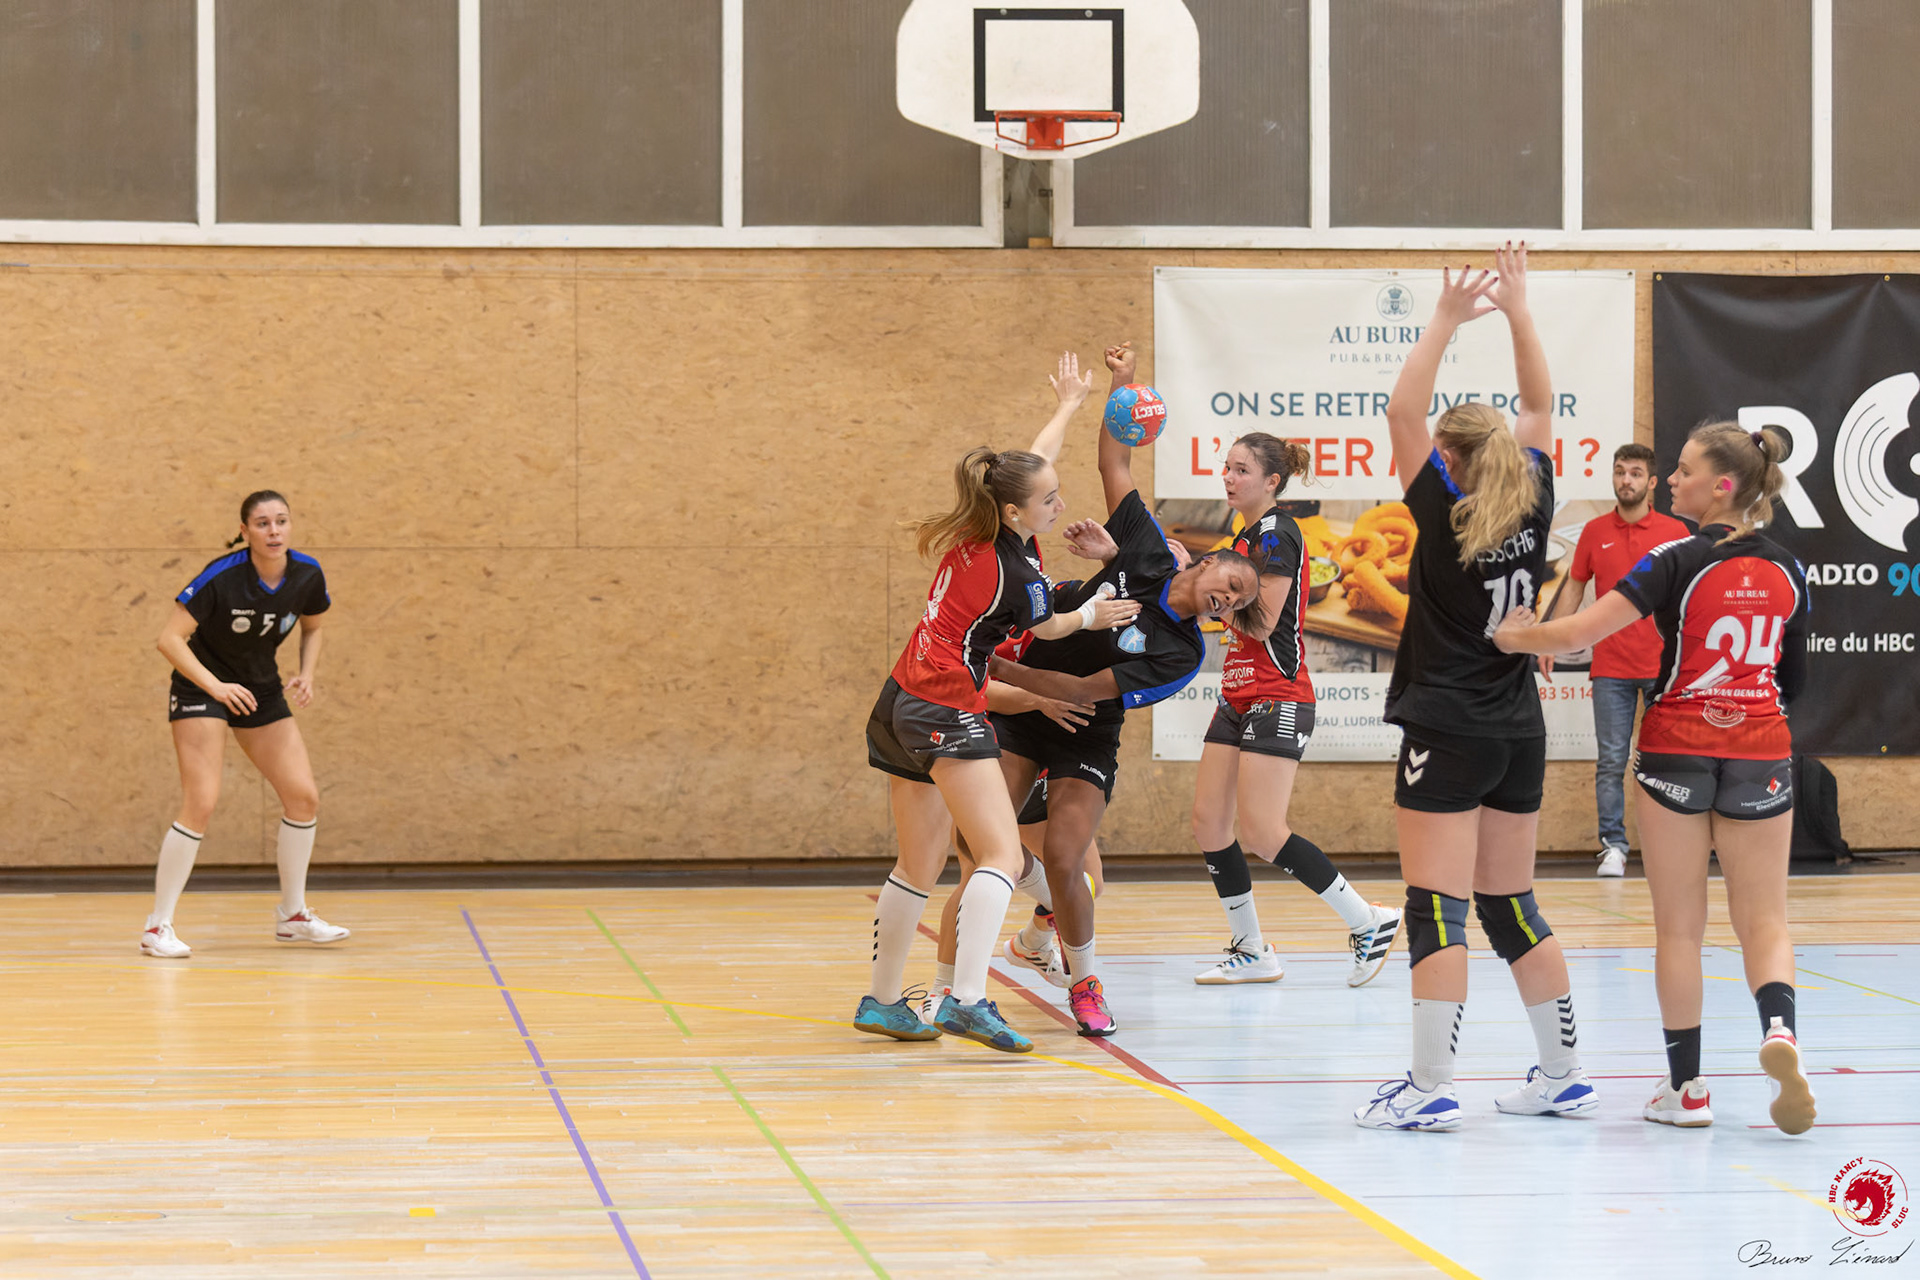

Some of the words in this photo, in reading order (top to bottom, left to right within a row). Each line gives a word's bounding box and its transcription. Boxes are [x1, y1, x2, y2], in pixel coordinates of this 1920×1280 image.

[1329, 325, 1361, 344] AU
[1134, 404, 1165, 420] SELECT
[1211, 391, 1258, 416] ON
[1270, 392, 1304, 416] SE
[1315, 393, 1480, 417] RETRUV
[1493, 393, 1577, 417] PR
[1578, 437, 1600, 477] ?
[1805, 563, 1879, 586] ADIO
[1484, 568, 1534, 640] 10
[1724, 590, 1735, 598] AU
[1736, 590, 1769, 598] BUREAU
[259, 613, 277, 637] 5
[1686, 615, 1783, 690] 24
[1842, 631, 1868, 653] du
[1873, 632, 1915, 653] HBC
[1315, 687, 1370, 701] UROTS
[1539, 686, 1556, 701] 83
[1315, 716, 1390, 728] EAU_LUDRE
[1654, 780, 1691, 800] INTER
